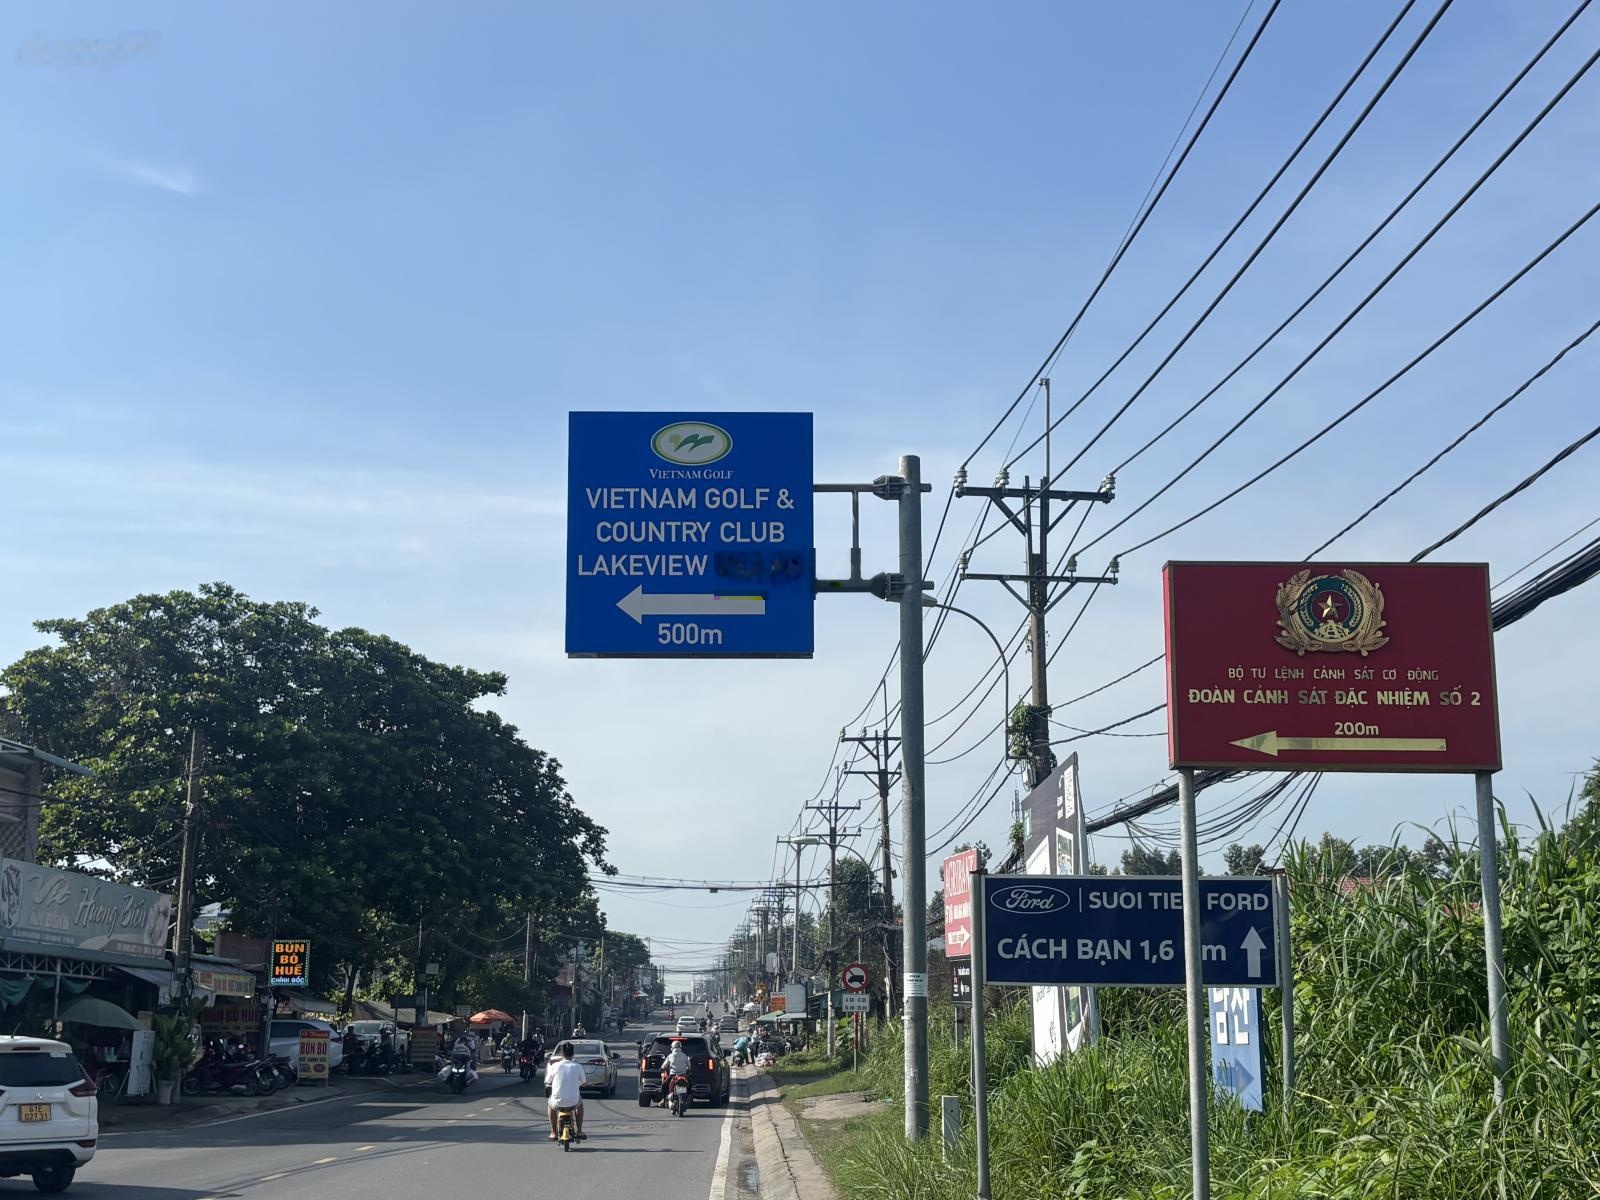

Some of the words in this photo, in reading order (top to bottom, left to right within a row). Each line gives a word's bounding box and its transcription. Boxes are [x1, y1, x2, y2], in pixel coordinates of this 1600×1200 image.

[649, 468, 701, 480] VIETNAM
[703, 468, 734, 480] GOLF
[585, 487, 697, 509] VIETNAM
[704, 487, 770, 509] GOLF
[777, 488, 795, 509] &
[596, 521, 711, 543] COUNTRY
[719, 521, 785, 543] CLUB
[577, 554, 708, 576] LAKEVIEW
[658, 622, 722, 645] 500m
[1228, 664, 1244, 681] BỘ
[1250, 666, 1267, 679] TƯ
[1274, 665, 1305, 681] LỆNH
[1313, 665, 1345, 680] CẢNH
[1353, 665, 1376, 680] SÁT
[1382, 668, 1397, 680] CƠ
[1407, 667, 1439, 684] ĐỘNG
[1187, 684, 1236, 704] ĐOÀN
[1242, 683, 1289, 704] CẢNH
[1297, 686, 1328, 705] SÁT
[1333, 687, 1368, 709] ĐẶC
[1376, 687, 1431, 709] NHIỆM
[1439, 684, 1462, 706] SỐ
[1470, 691, 1481, 706] 2
[1334, 721, 1379, 736] 200m
[1005, 888, 1055, 910] Ford
[1087, 890, 1142, 910] SUOI
[1148, 891, 1184, 910] TIE
[1207, 892, 1269, 911] FORD
[997, 933, 1067, 959] CÁCH
[1077, 938, 1132, 966] BẠN
[1139, 939, 1175, 964] 1,6
